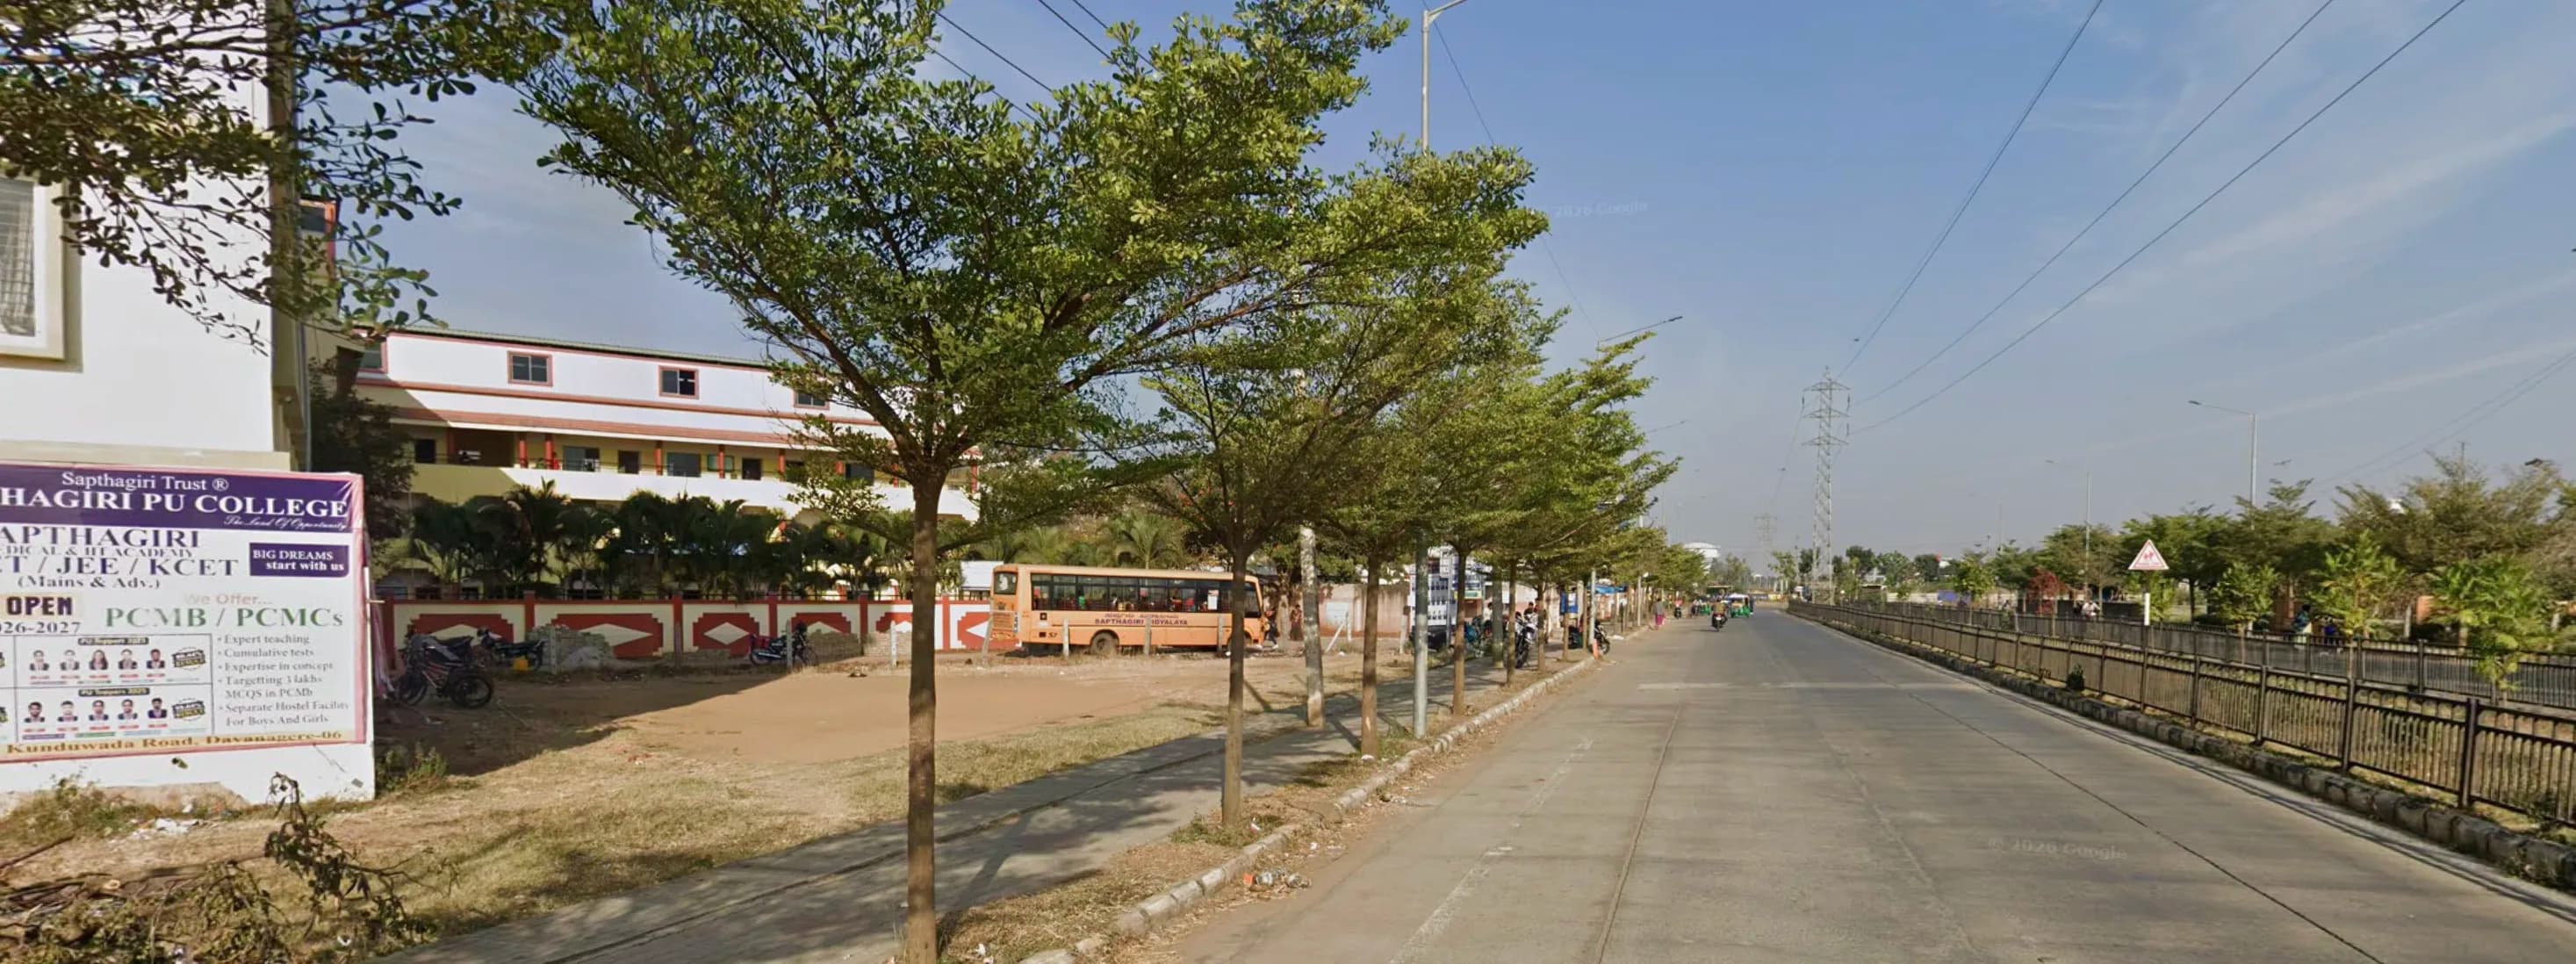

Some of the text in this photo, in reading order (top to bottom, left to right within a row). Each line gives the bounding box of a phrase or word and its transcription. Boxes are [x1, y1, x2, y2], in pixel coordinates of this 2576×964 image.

[61, 471, 156, 492] Sapthagiri
[162, 476, 207, 491] Trust
[0, 487, 349, 517] HAGIRI PU COLLEGE
[224, 514, 347, 531] The Land Of Opportunity
[0, 527, 199, 548] APTHAGIRI
[0, 544, 61, 556] DICAL
[64, 546, 78, 557] &
[114, 548, 193, 558] ACADEMY
[253, 550, 334, 561] BIG DREAMS
[0, 555, 239, 577] T / JEE / KCET
[266, 561, 345, 572] start with us
[18, 575, 161, 590] (Mains & Adv.)
[6, 596, 73, 616] OPEN
[106, 607, 207, 628] PCMB
[237, 607, 344, 627] PCMCs
[224, 634, 310, 646] Expert teaching
[224, 647, 315, 658] Cumulative tests
[224, 661, 334, 673] Expertise in concept
[225, 689, 263, 701] MCQS
[266, 689, 277, 699] in
[226, 703, 274, 715] Separate
[276, 701, 310, 712] Hostel
[226, 714, 329, 728] For Boys And Girls
[7, 739, 134, 753] Kunduwada
[206, 730, 342, 744] Davanagere-06
